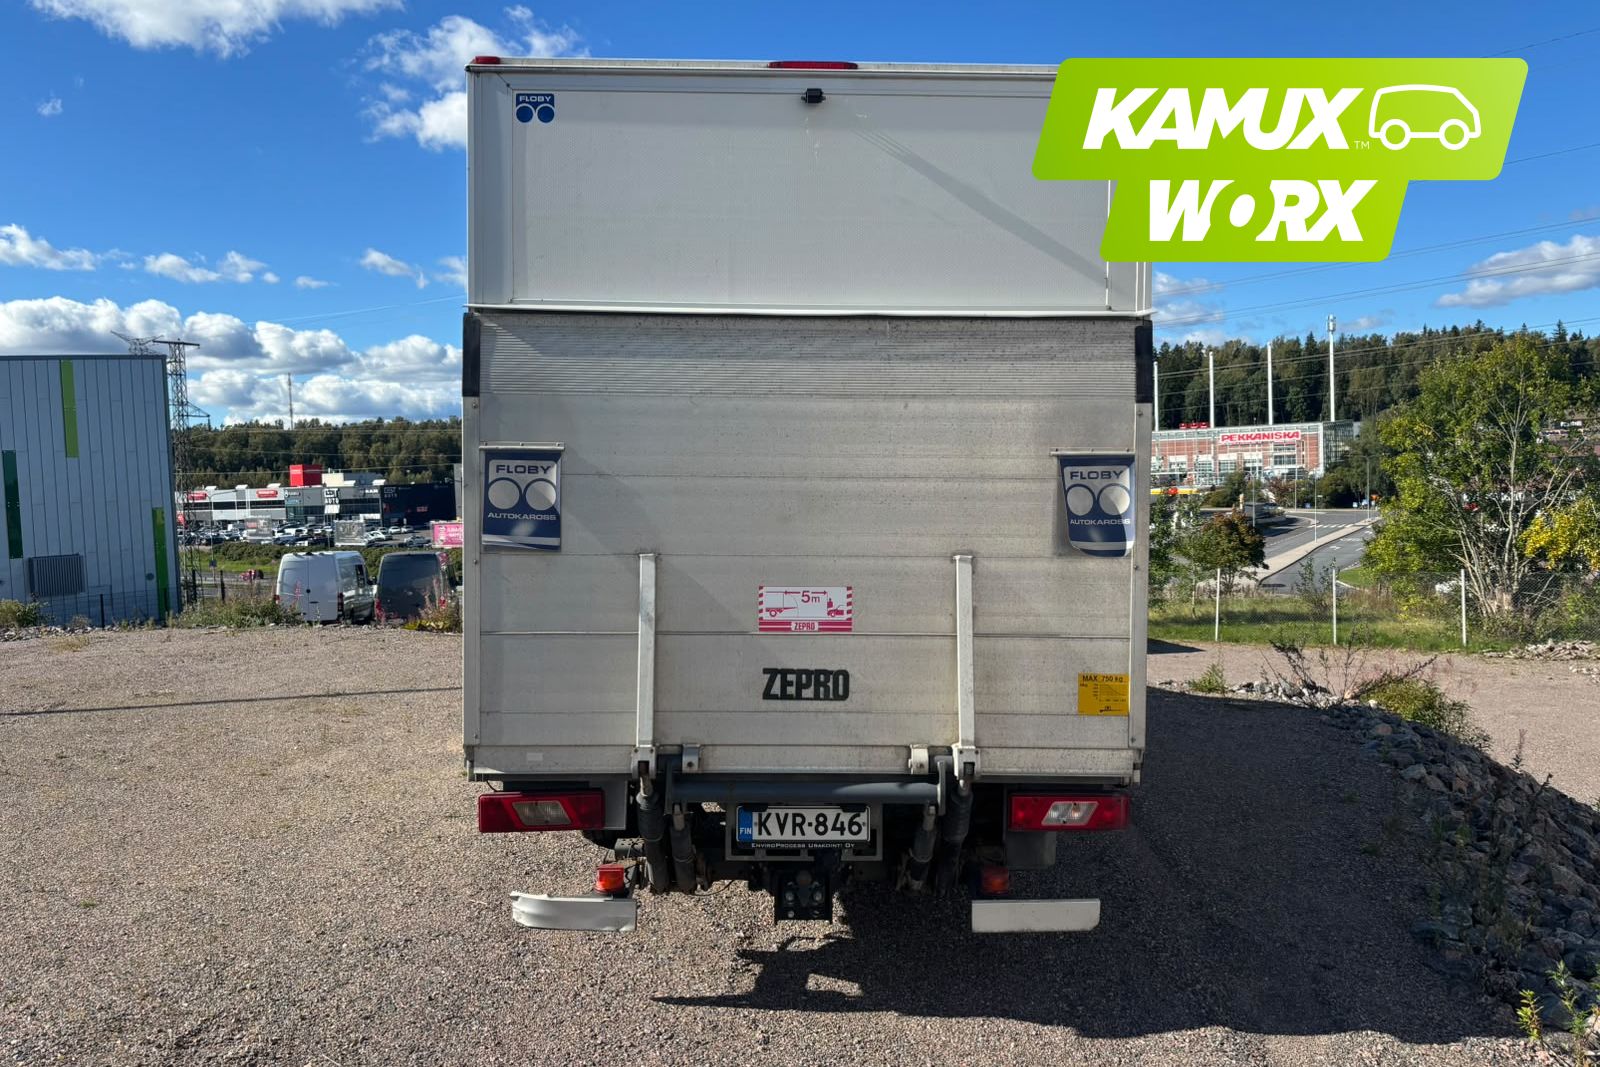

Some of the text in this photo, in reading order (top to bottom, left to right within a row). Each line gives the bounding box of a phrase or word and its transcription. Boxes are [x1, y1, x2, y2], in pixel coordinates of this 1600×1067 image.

[1221, 431, 1300, 442] PEKKANISKA
[496, 465, 551, 474] FLOBY
[1070, 470, 1124, 480] FLOBY
[488, 512, 556, 520] AUTOKAROSS
[1070, 518, 1131, 526] AUTOKAROSS
[794, 622, 815, 631] ZEPRO
[762, 667, 850, 701] ZEPRO
[758, 813, 863, 835] KVR-846
[739, 827, 752, 835] FIN
